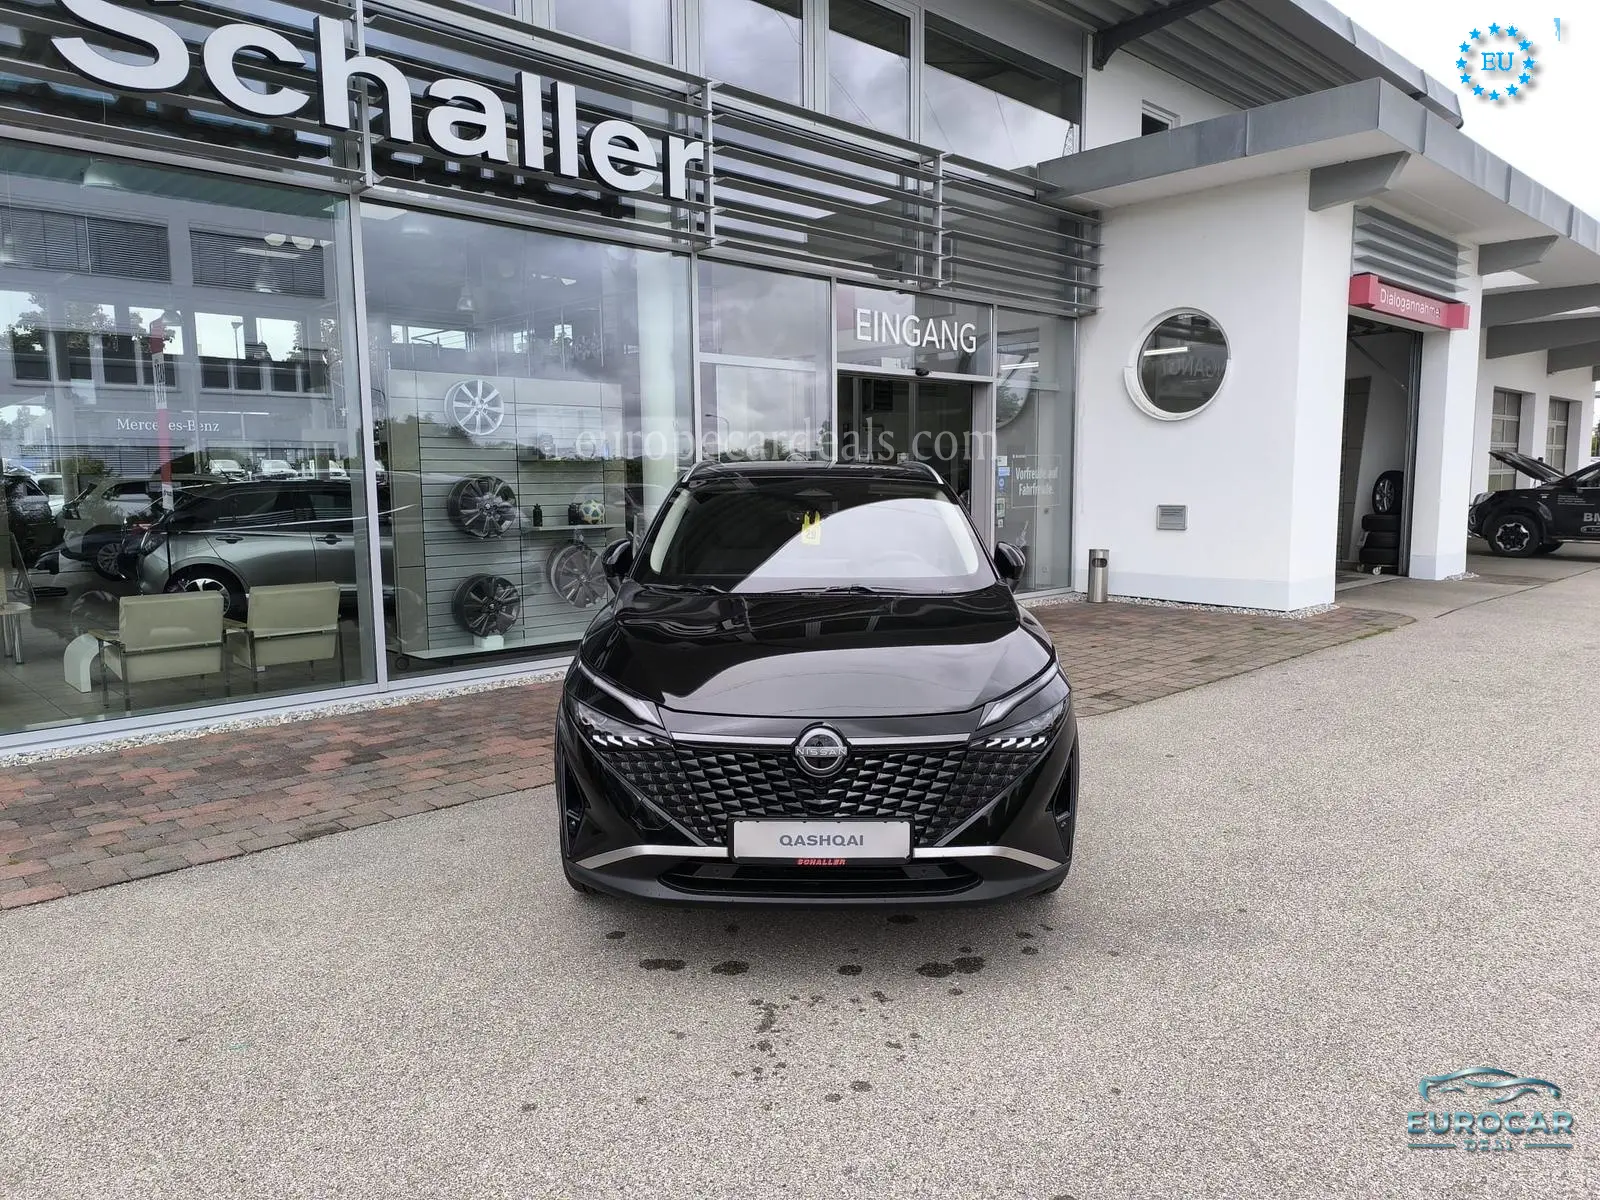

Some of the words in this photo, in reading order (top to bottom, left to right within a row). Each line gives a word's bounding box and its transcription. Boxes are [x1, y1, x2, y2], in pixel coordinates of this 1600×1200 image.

[51, 0, 704, 202] Schaller
[1380, 288, 1441, 319] Dialogannahme
[856, 308, 977, 354] EINGANG
[116, 419, 220, 432] Mercees-Benz
[796, 748, 848, 756] NISSAN
[779, 834, 864, 847] QASHQAI
[797, 858, 846, 867] SCHALLER
